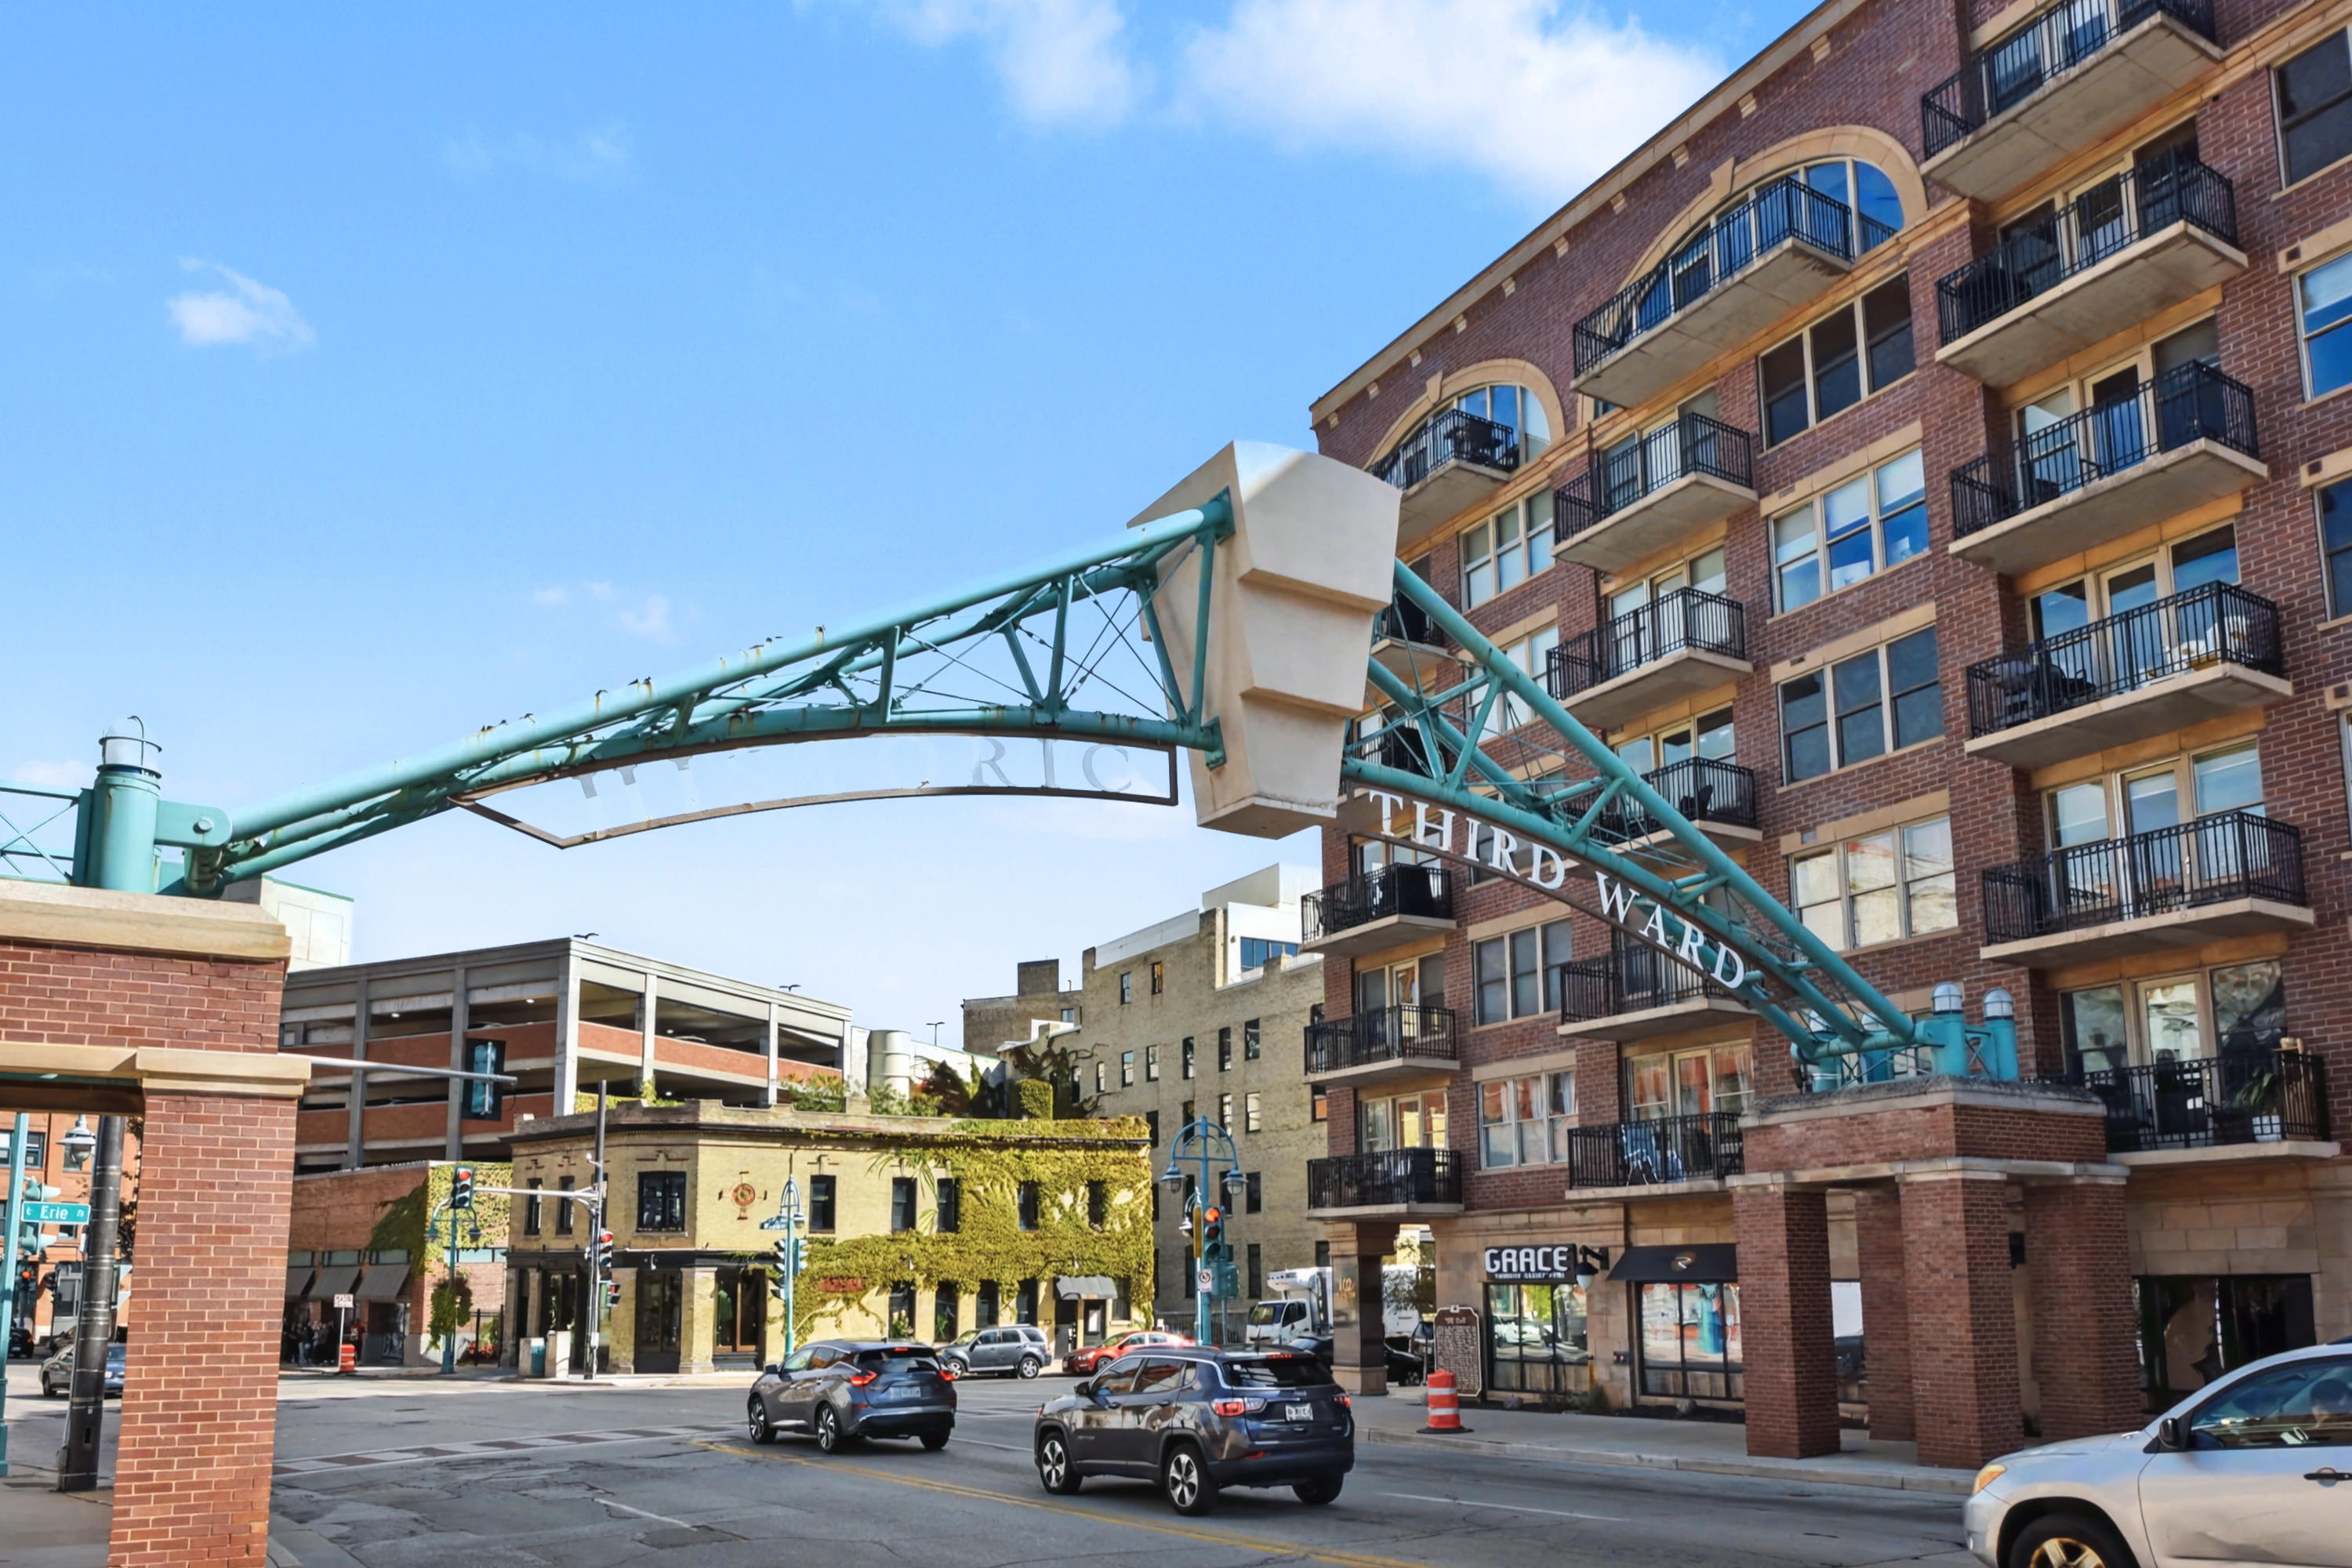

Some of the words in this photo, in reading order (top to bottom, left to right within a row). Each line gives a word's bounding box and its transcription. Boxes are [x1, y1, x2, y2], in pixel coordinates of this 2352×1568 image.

[1369, 789, 1566, 890] THIRD
[1595, 870, 1744, 989] WARD
[40, 1205, 69, 1220] Erie
[1485, 1247, 1569, 1273] GRACE
